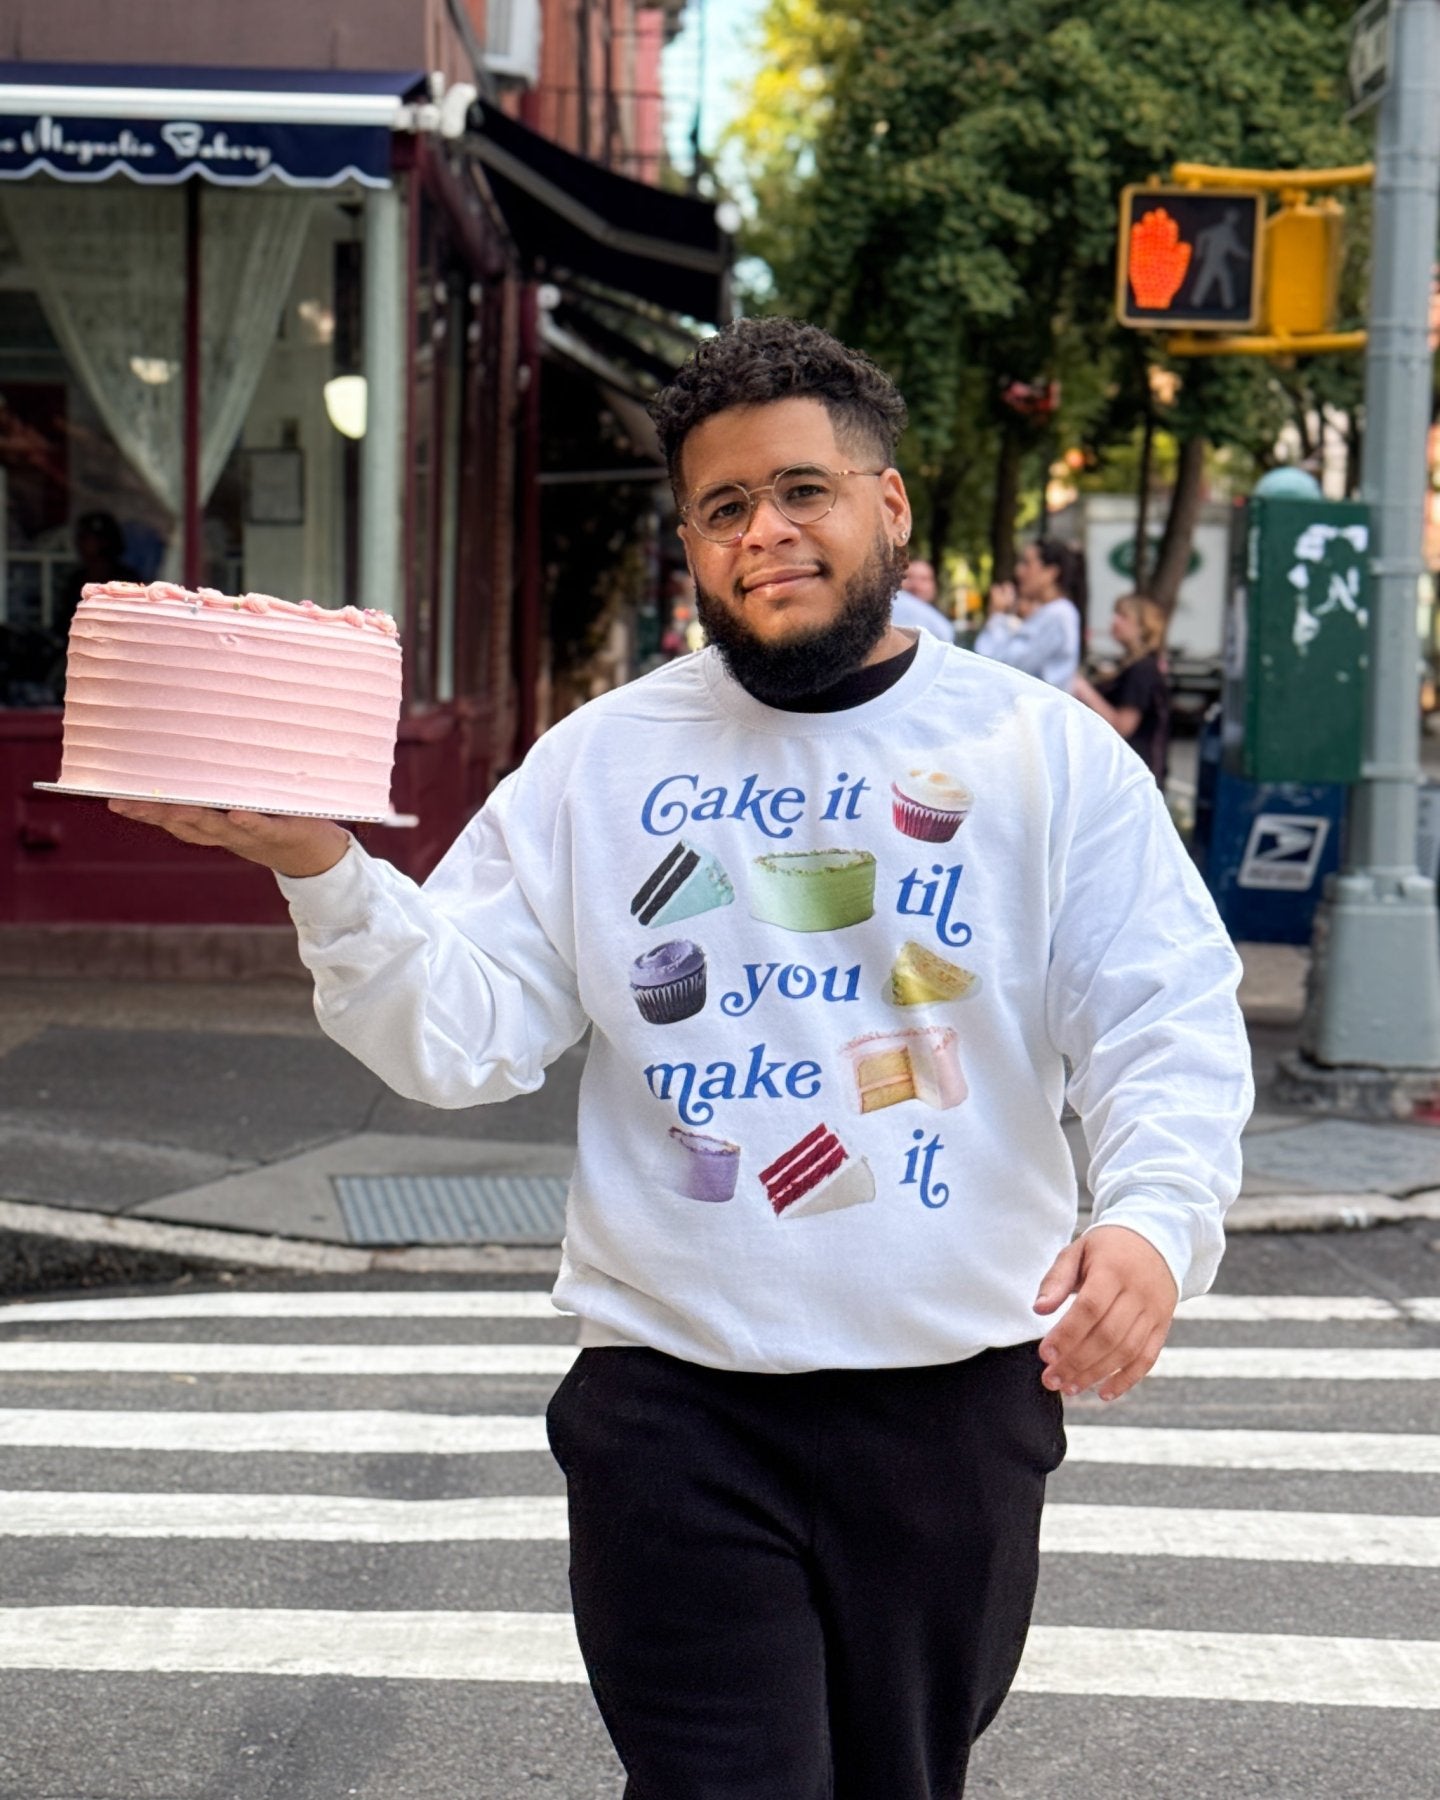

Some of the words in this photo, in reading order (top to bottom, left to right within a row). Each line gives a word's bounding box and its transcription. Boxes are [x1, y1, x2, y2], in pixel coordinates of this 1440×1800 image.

[641, 773, 806, 839] Cake
[820, 771, 871, 822] it
[895, 864, 973, 948] til
[719, 962, 861, 1018] you
[643, 1043, 823, 1126] make
[899, 1128, 950, 1209] it
